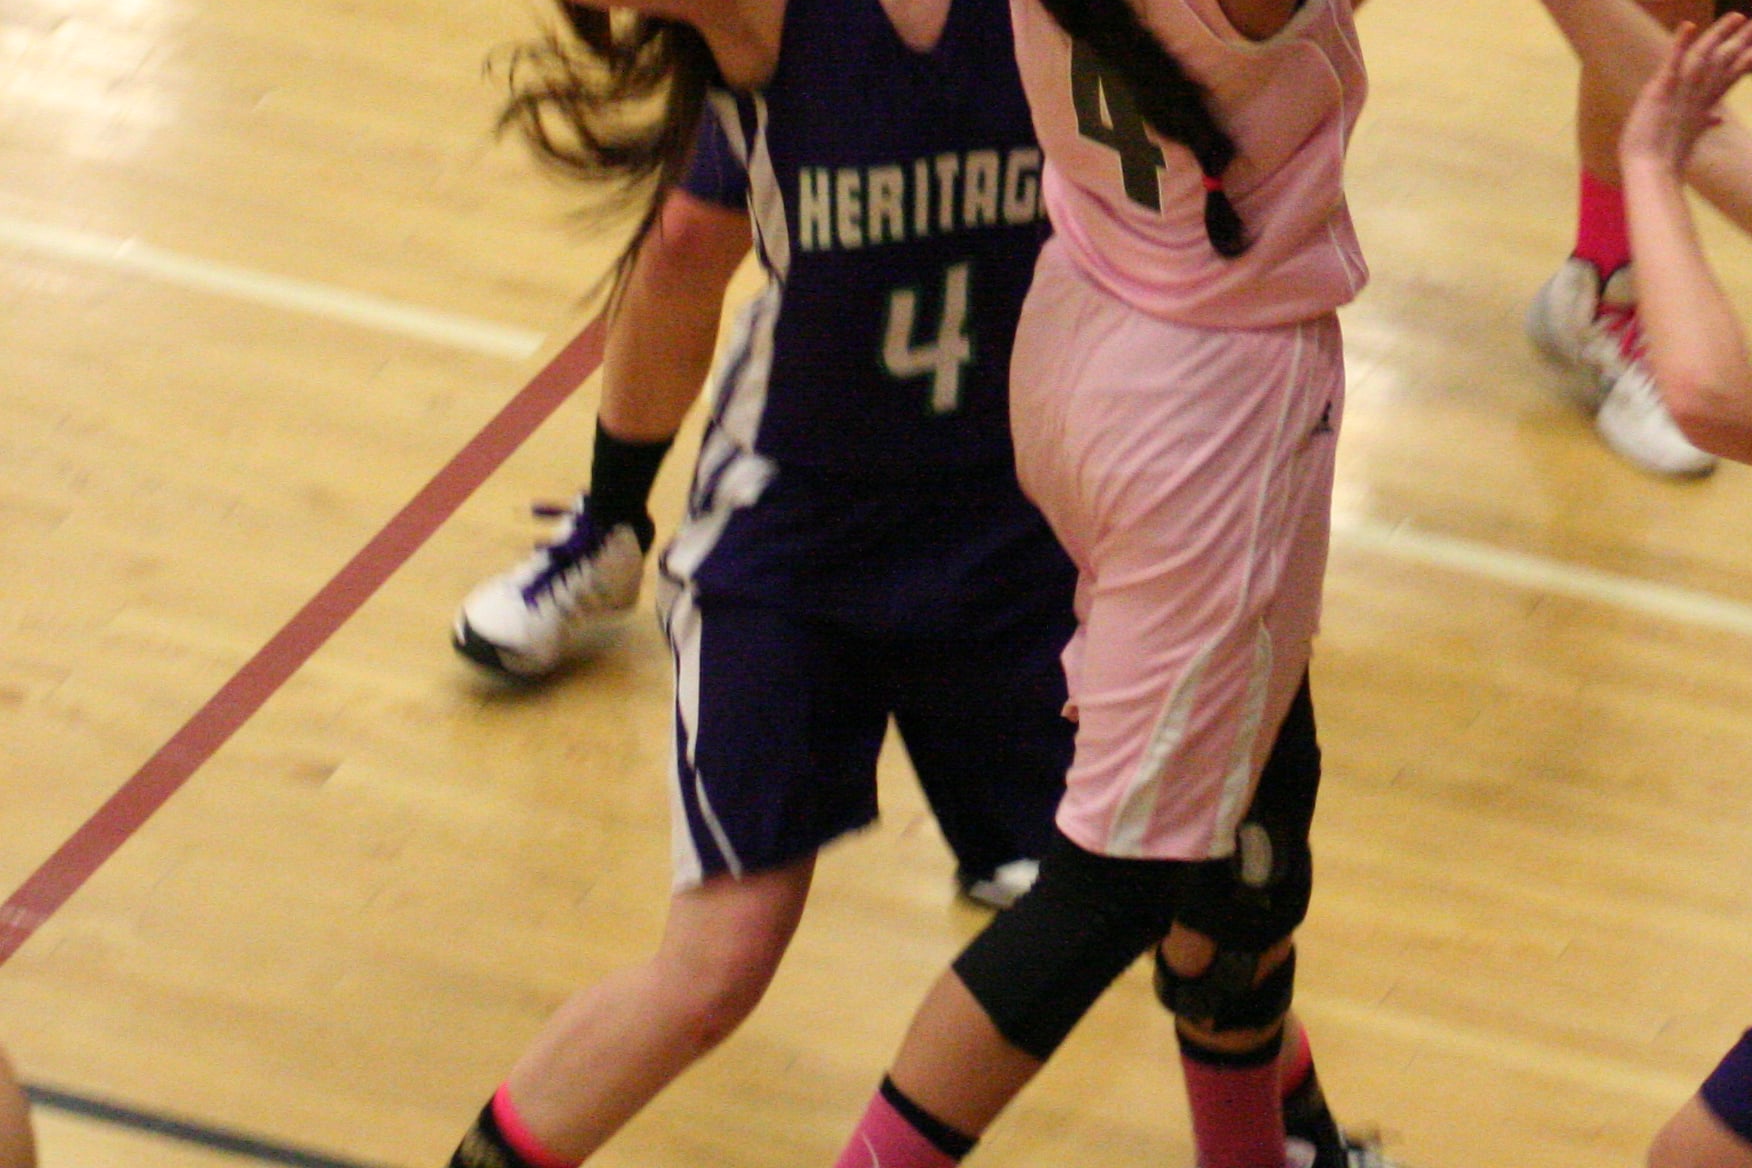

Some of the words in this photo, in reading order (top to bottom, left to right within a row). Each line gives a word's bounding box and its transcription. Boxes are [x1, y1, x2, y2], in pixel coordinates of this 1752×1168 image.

[799, 146, 1048, 252] HERITAG
[1069, 35, 1167, 216] 4
[883, 261, 971, 412] 4
